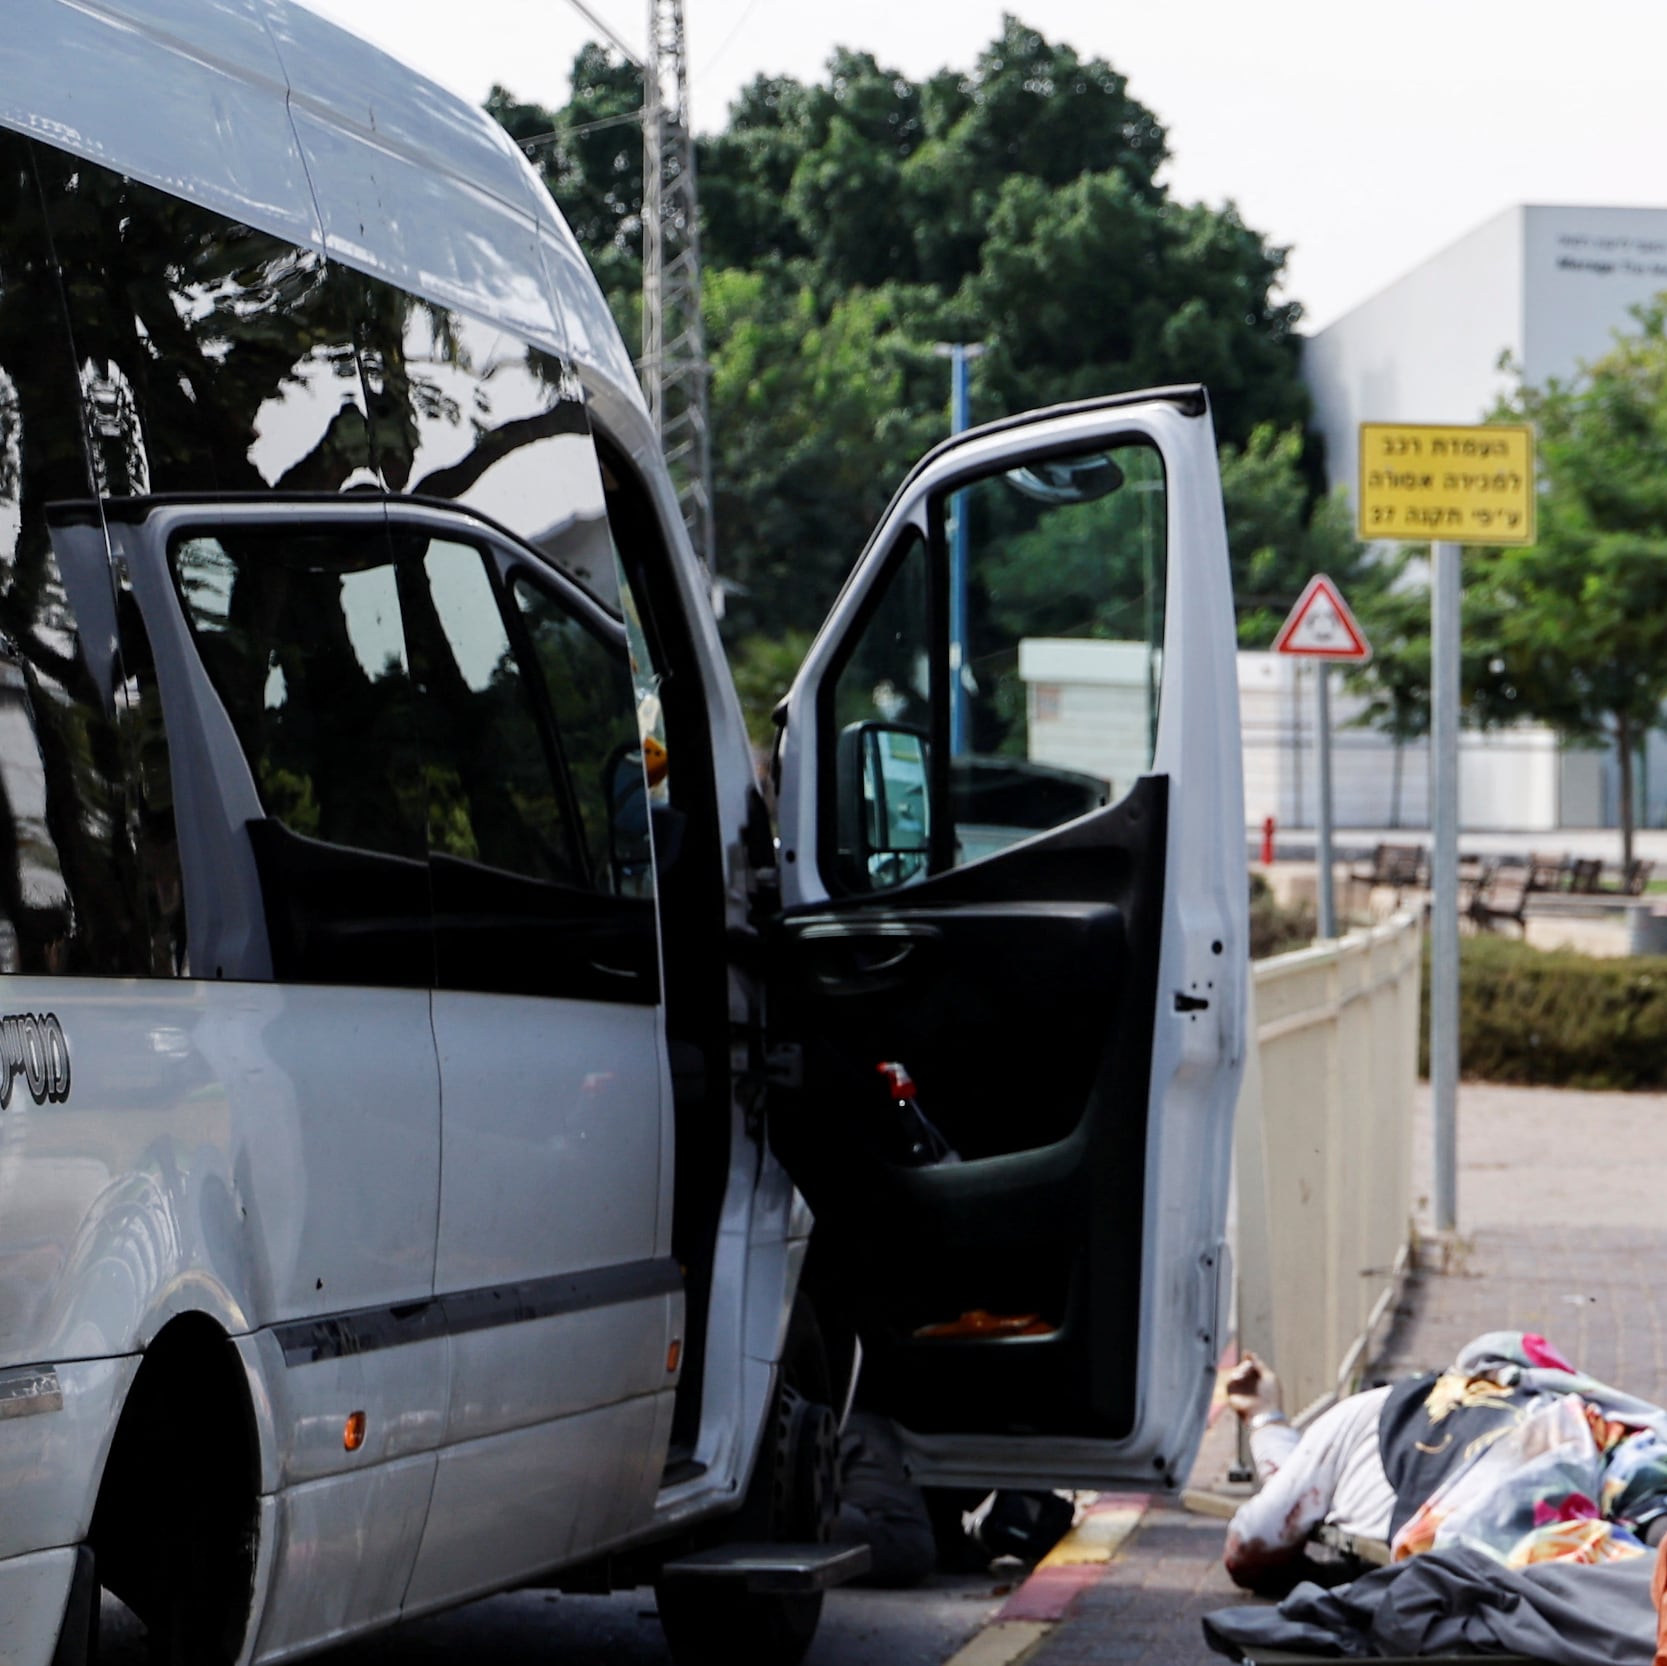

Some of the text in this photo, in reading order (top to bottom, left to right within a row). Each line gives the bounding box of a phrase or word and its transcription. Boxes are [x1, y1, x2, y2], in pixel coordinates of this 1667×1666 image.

[1383, 436, 1509, 457] העמדת רכב
[1369, 470, 1521, 492] למכירה אסורה
[1405, 506, 1463, 527] תקנה
